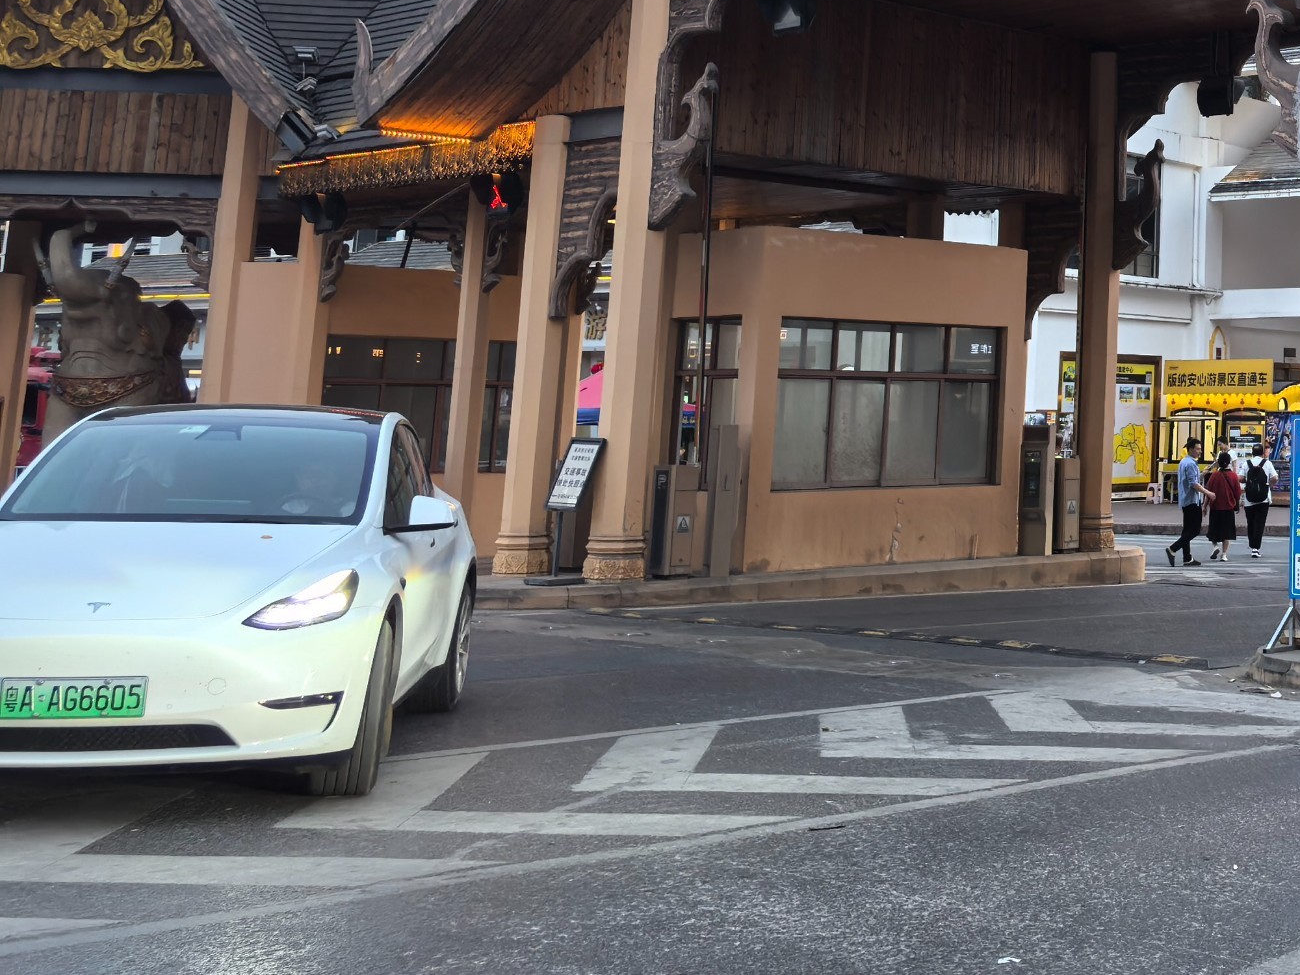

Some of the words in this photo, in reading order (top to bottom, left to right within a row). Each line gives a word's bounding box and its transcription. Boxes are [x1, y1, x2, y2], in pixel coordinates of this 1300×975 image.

[1167, 372, 1268, 387] 版纳安心游景区直通车
